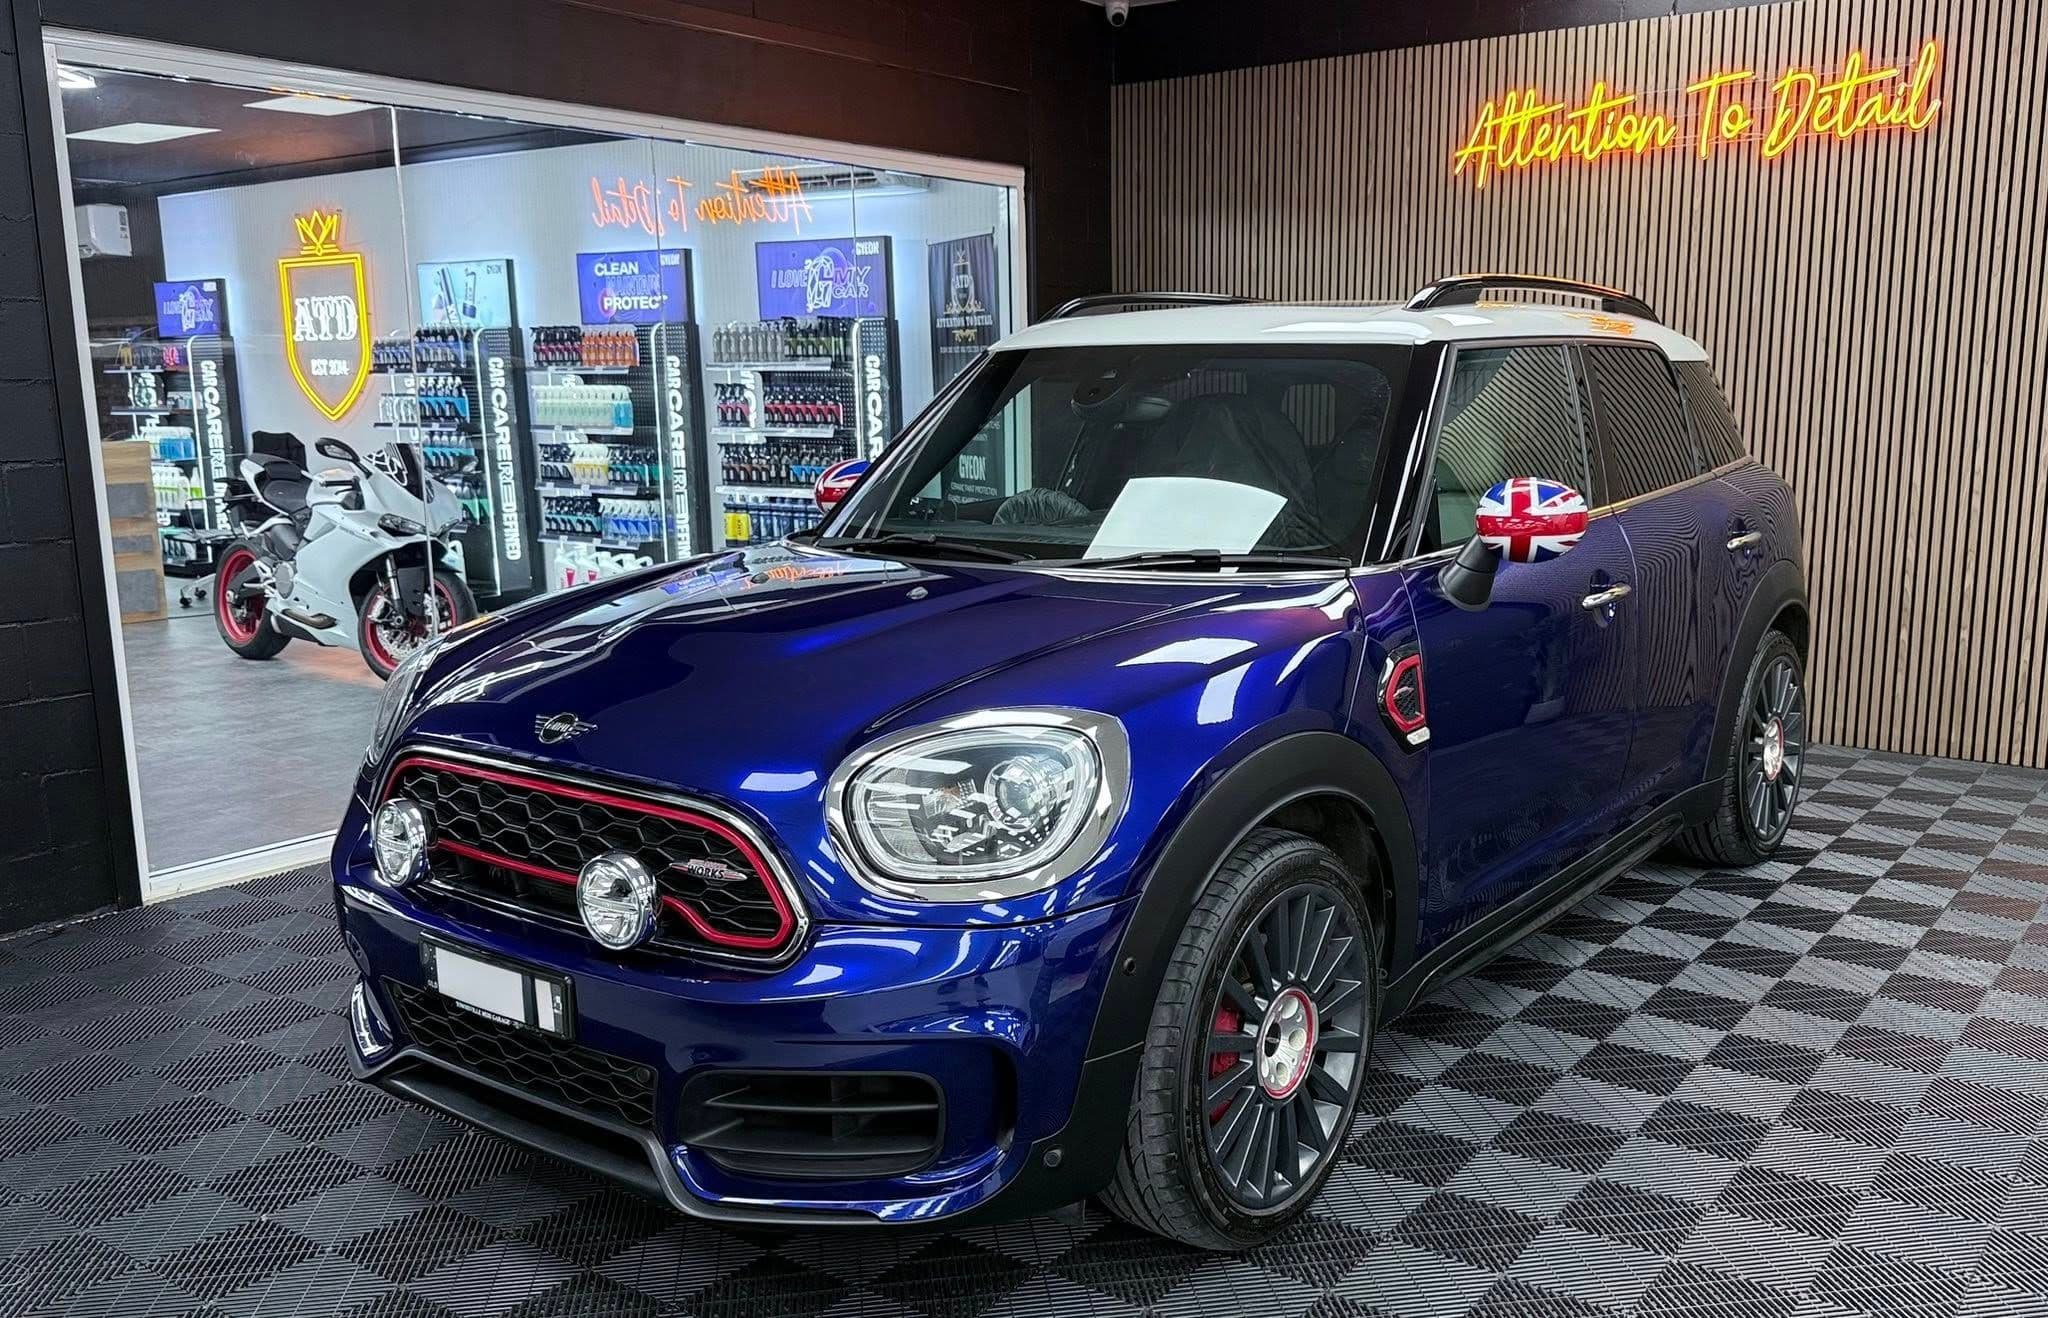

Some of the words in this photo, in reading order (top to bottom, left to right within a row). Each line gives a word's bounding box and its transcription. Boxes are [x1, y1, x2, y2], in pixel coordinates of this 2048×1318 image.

[1455, 81, 1675, 187] Attention
[1687, 71, 1753, 158] To
[1762, 41, 1941, 159] Detail
[594, 262, 639, 276] CLEAN
[834, 265, 871, 286] MY
[833, 284, 869, 298] CAR
[293, 295, 358, 342] ATD
[201, 360, 218, 386] CAR
[311, 359, 328, 376] EST
[488, 357, 505, 388] CAR
[666, 355, 681, 389] CAR
[865, 355, 881, 392] CAR
[203, 386, 225, 449] CARE
[491, 387, 513, 461] CARE
[668, 388, 686, 468] CARE
[867, 391, 884, 465] CAR
[959, 454, 986, 480] GYEON
[498, 461, 522, 560] REDEFINED
[673, 468, 691, 560] REDEFIN
[688, 864, 724, 879] WORKS
